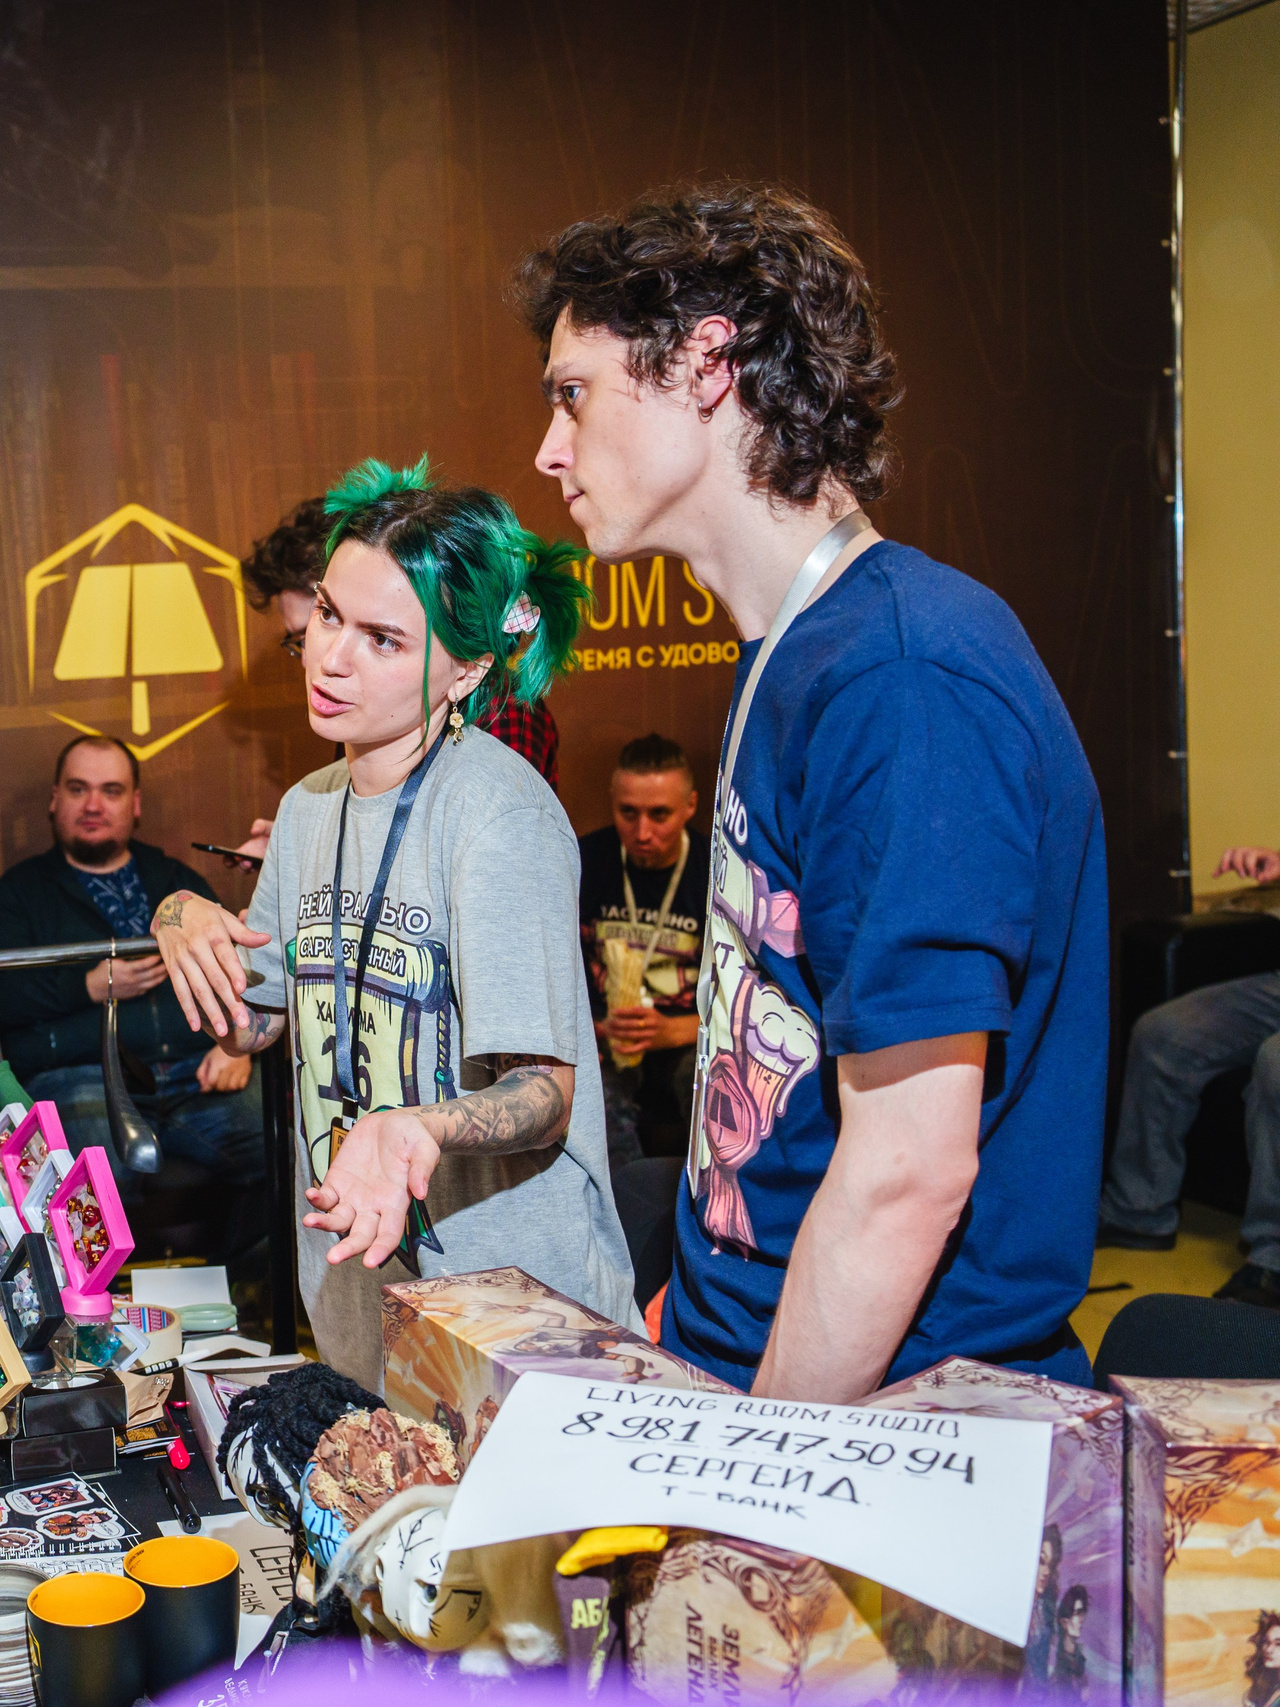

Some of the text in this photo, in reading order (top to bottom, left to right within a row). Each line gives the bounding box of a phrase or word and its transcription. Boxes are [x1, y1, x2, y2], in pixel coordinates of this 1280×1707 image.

[586, 1387, 960, 1438] LIVING ROOM STUDIO
[561, 1411, 976, 1484] 8 981 747 50 94
[629, 1452, 814, 1493] СЕРГЕЙ
